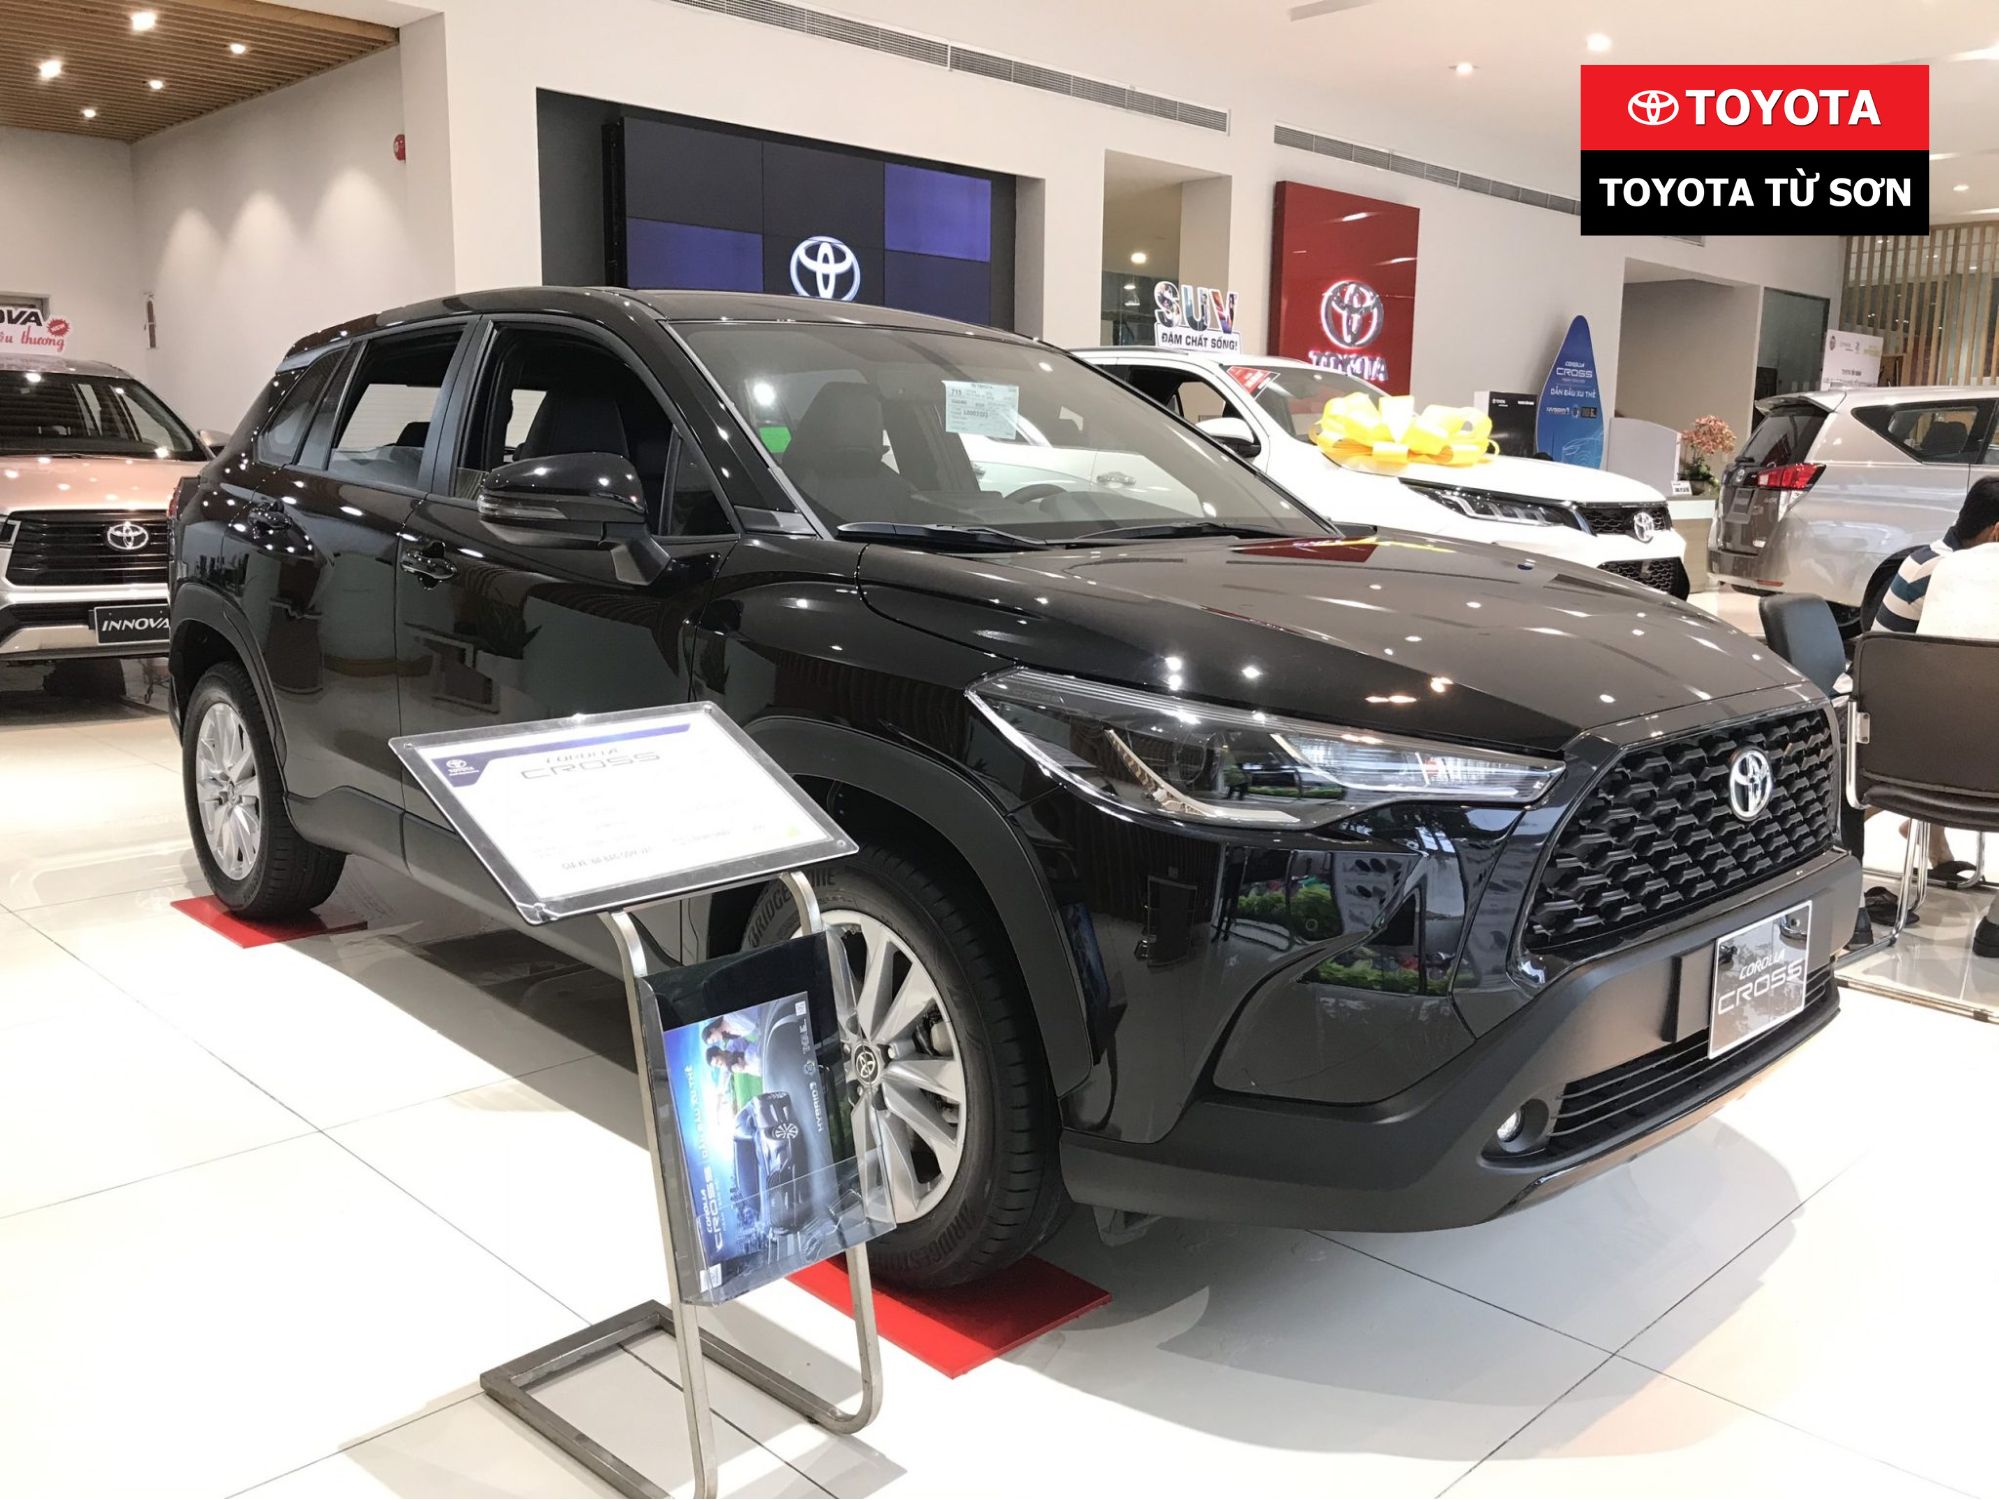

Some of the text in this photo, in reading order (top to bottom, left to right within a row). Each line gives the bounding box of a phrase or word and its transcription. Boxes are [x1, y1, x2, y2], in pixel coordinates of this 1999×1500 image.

[1154, 281, 1239, 334] SUV
[1556, 367, 1593, 378] CROSS
[102, 618, 170, 632] INNOVA
[520, 751, 661, 780] CROSS
[1739, 950, 1785, 980] COROLLA
[1717, 958, 1804, 1015] CROSS
[704, 1165, 724, 1253] CROSS
